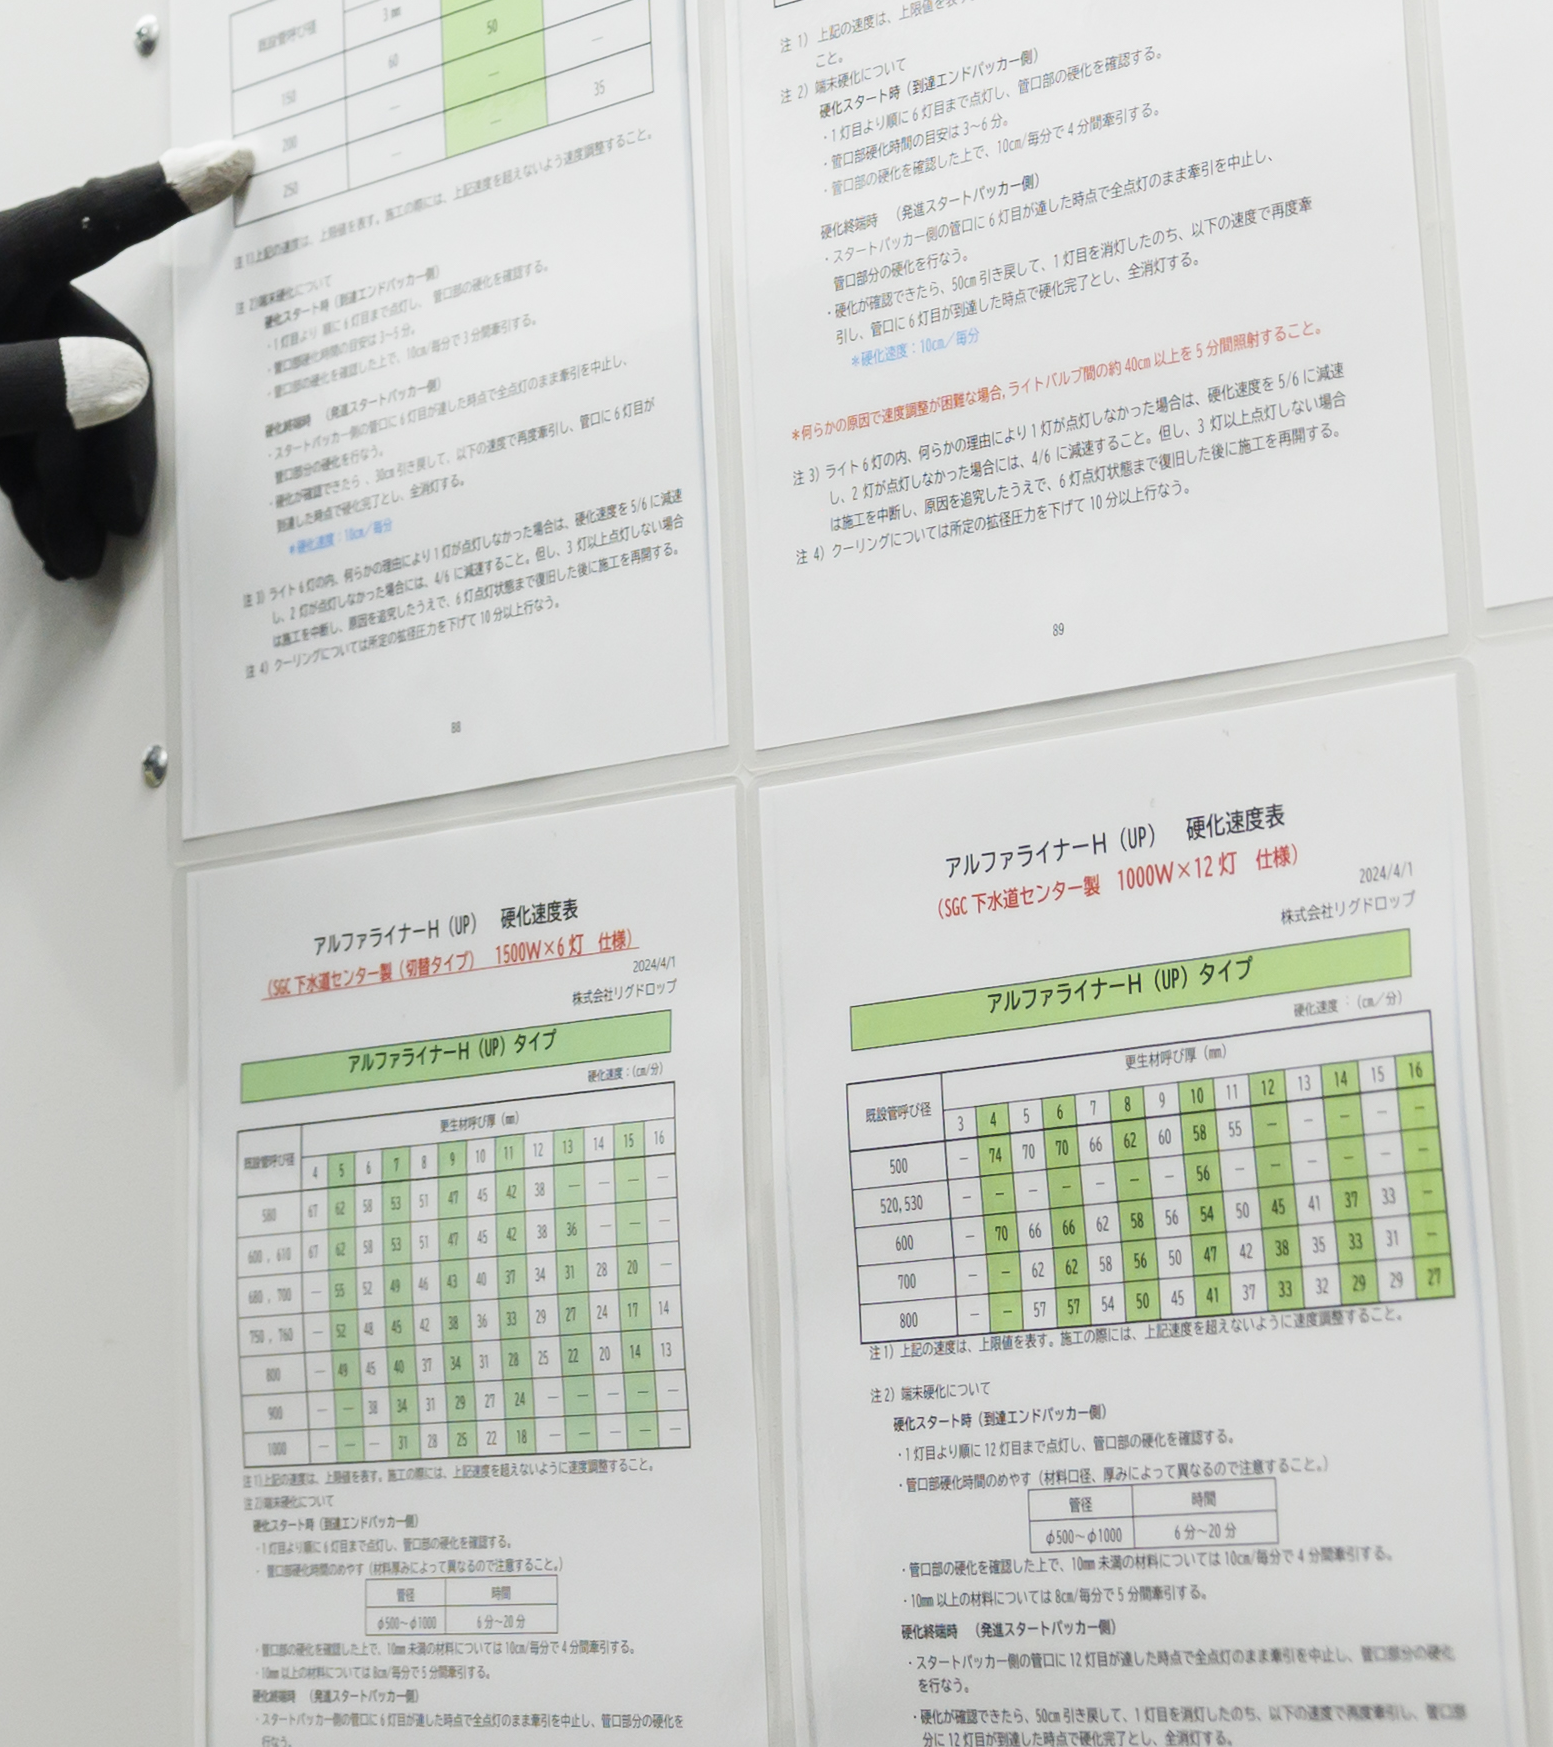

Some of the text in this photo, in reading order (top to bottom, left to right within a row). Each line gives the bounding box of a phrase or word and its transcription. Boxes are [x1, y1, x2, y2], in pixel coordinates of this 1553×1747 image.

[485, 17, 499, 36] 50
[815, 50, 844, 69] こと。
[1051, 621, 1065, 637] 89
[1185, 802, 1285, 842] 硬化速度表
[1358, 860, 1413, 885] 2024/4/1
[500, 897, 579, 930] 硬化速度表
[1279, 889, 1416, 926] 株式会社リグドロップ
[632, 955, 676, 974] 2024/4/1
[571, 977, 678, 1006] 株式会社リグドロップ
[956, 1060, 1424, 1132] 3 4 5 6 7 8 9 10 11 12 13 14 15 16
[864, 1100, 932, 1123] 既設管呼び径
[532, 1129, 665, 1158] 12 15 16
[888, 1119, 1243, 1175] 500 74 70 70 66 62 60 58 55
[1195, 1163, 1211, 1183] 56
[894, 1186, 1397, 1252] 600 70 66 66 62 58 56 54 50 45 41 37 33
[896, 1272, 917, 1290] 700
[898, 1310, 919, 1329] 800
[1068, 1489, 1217, 1514] 管径 時間
